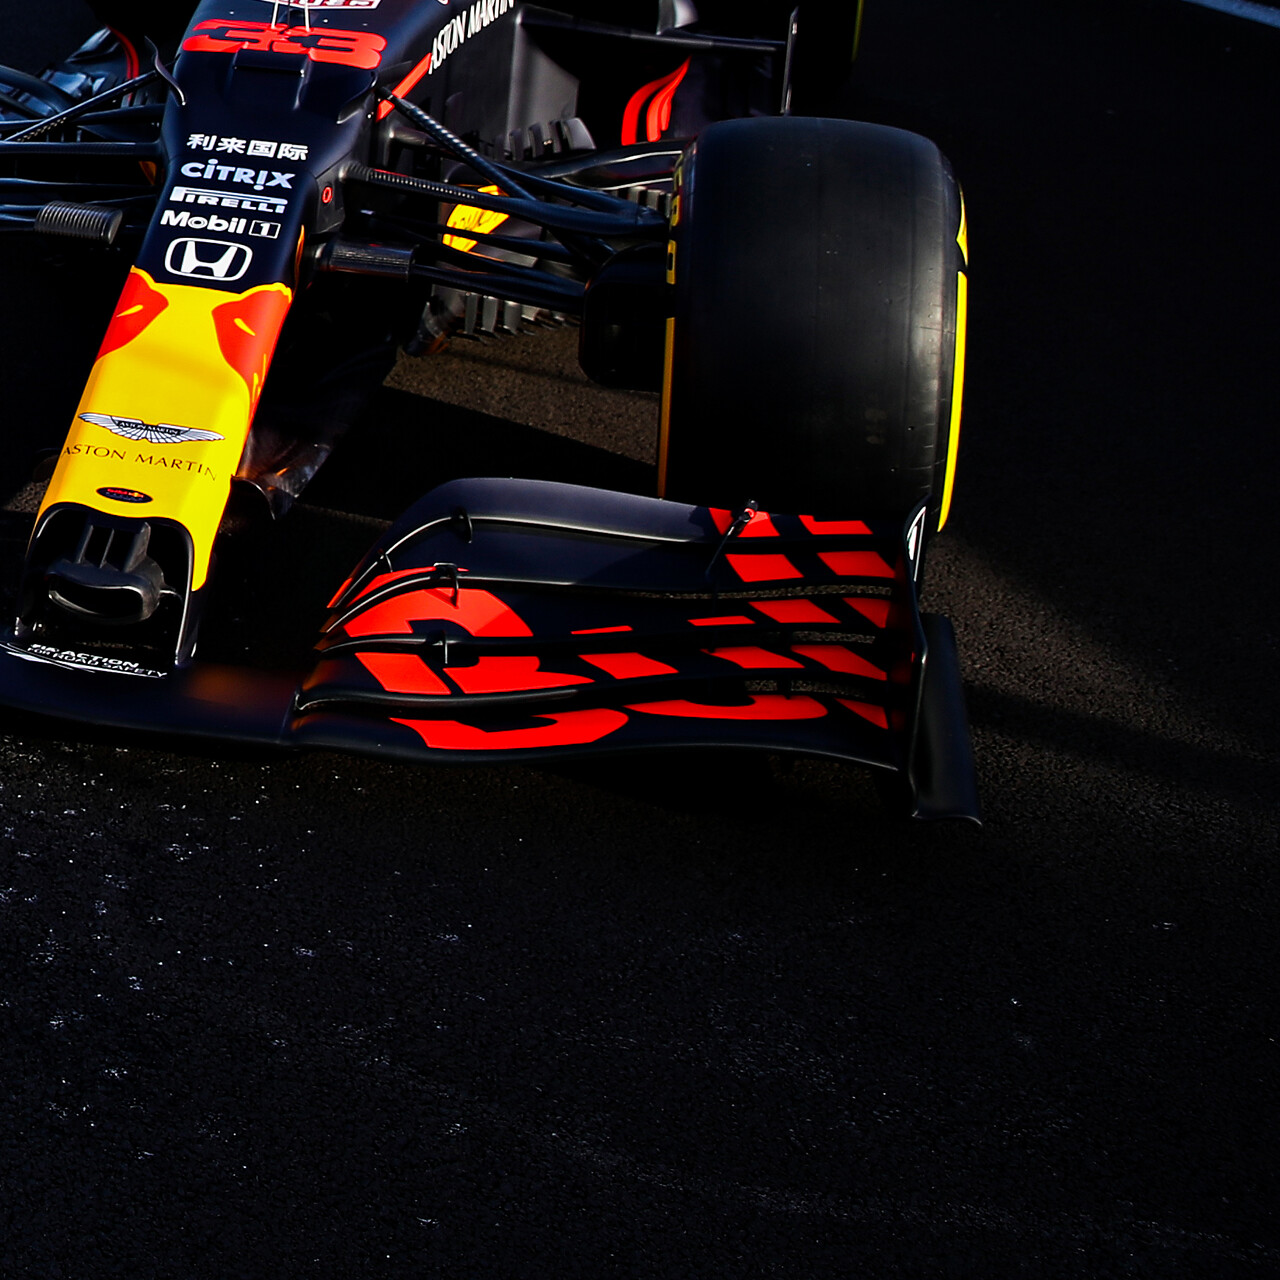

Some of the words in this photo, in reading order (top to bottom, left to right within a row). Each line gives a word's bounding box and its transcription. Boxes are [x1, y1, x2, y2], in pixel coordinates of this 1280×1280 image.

[182, 18, 388, 70] 33
[428, 10, 468, 75] ASTON
[186, 133, 309, 161] 利来国际
[169, 186, 289, 214] PIRELLI
[160, 209, 247, 234] Mobil
[62, 443, 127, 461] ASTON
[134, 453, 217, 481] MARTIN
[62, 650, 140, 668] ACTION
[103, 662, 168, 678] SAFETY
